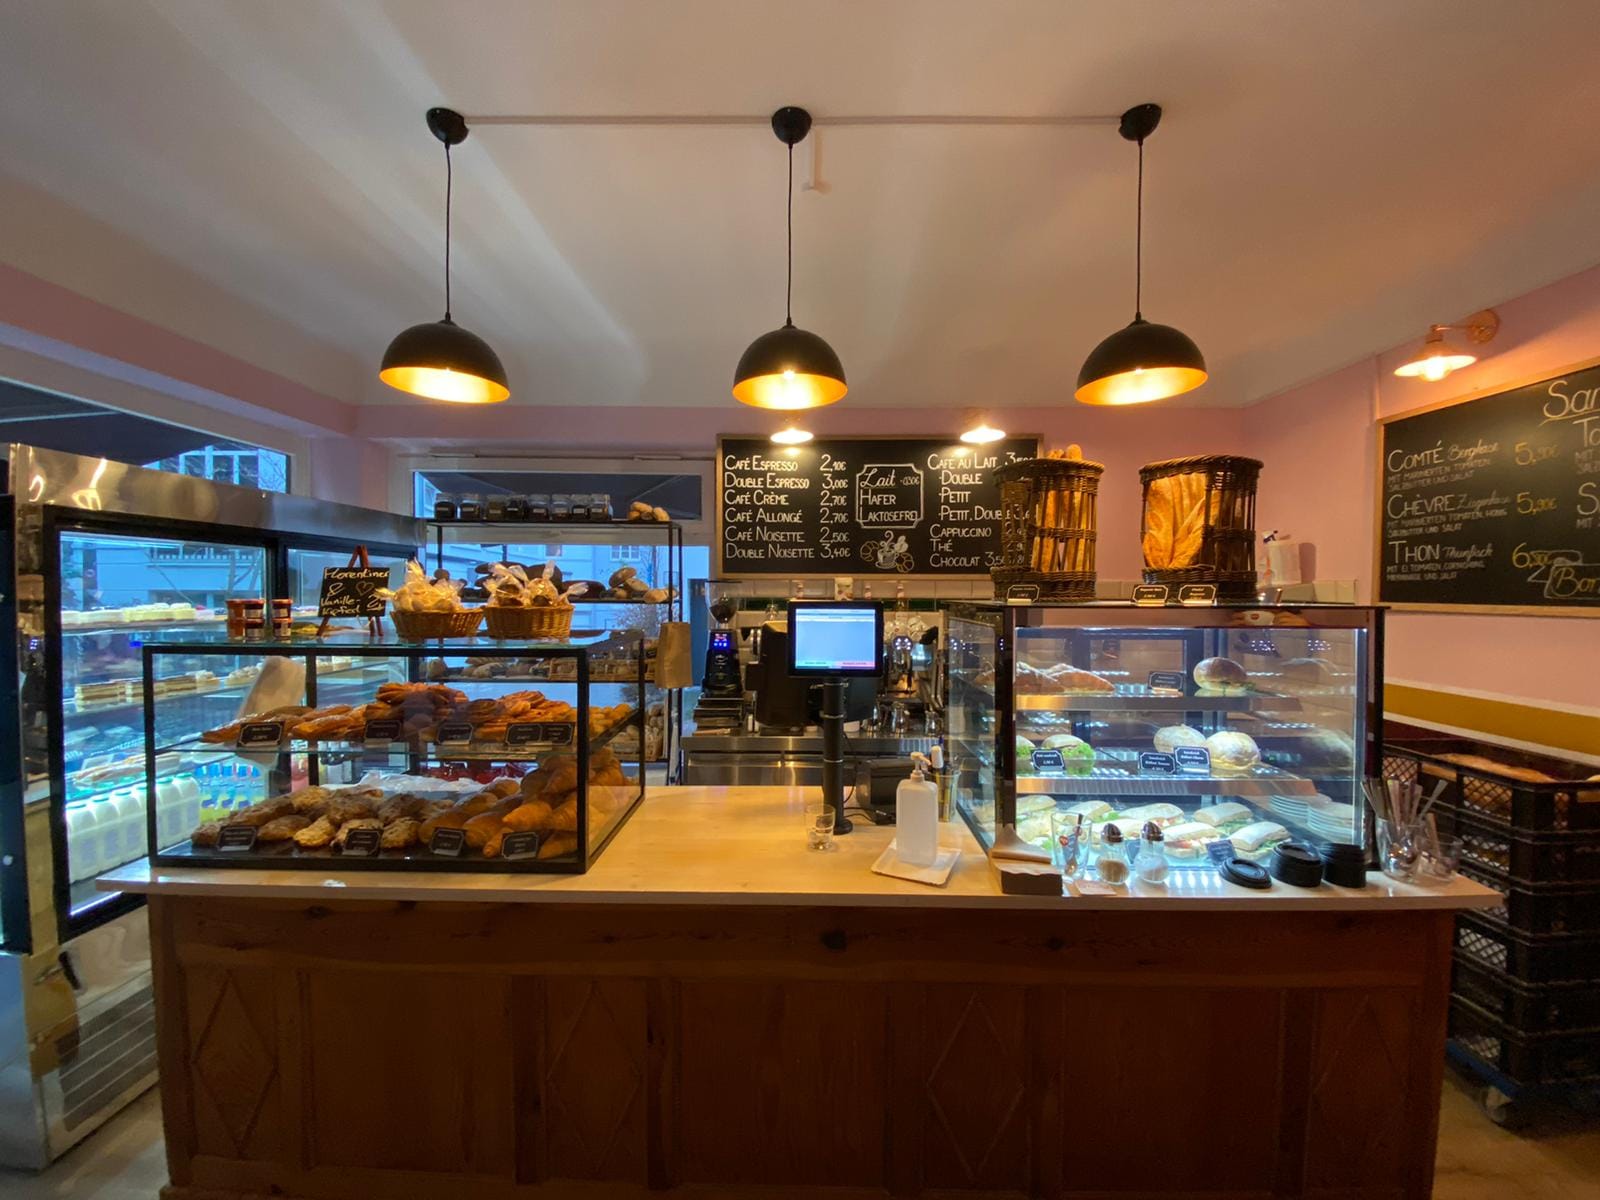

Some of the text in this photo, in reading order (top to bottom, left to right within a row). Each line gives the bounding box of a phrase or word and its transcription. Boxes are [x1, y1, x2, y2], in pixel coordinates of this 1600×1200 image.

[724, 454, 751, 471] CAFÉ
[752, 454, 799, 472] ESPRESSO
[957, 459, 973, 469] AU
[974, 452, 998, 469] LAIT
[1387, 440, 1444, 473] COMTÉ
[724, 471, 764, 489] DOUBLE
[766, 472, 810, 489] ESPRESSO
[860, 467, 896, 488] Lait
[724, 489, 751, 505] CAFÉ
[753, 489, 789, 505] CRÈME
[859, 488, 897, 506] HAFER
[725, 507, 849, 524] CAFÉ ALLONGÉ 2,70€
[1387, 494, 1456, 520] CHÈVRE
[724, 525, 850, 543] CAFÉ NOISETTE 2,50€
[929, 523, 992, 539] CAPPUCCINO
[725, 542, 766, 559] DOUBLE
[768, 543, 816, 559] NOISETTE
[929, 538, 953, 552] THÉ
[1388, 540, 1441, 565] THON
[929, 552, 981, 568] CHOCOLAT
